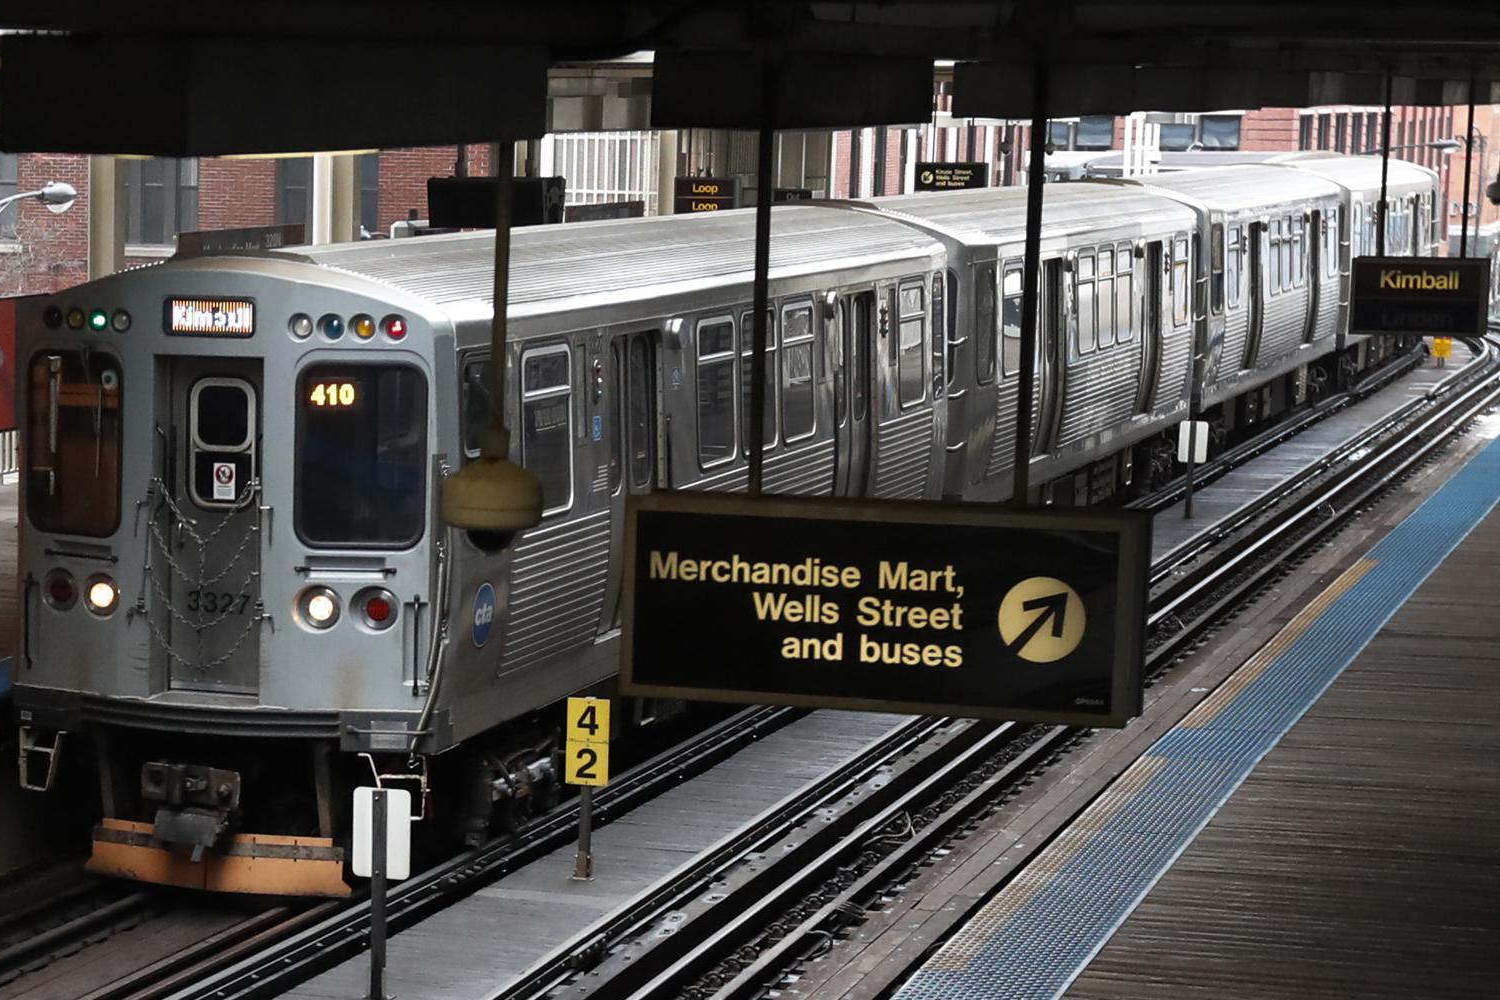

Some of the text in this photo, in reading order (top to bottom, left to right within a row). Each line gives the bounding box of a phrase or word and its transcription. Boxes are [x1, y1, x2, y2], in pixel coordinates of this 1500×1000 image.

[692, 183, 719, 195] Loop
[692, 201, 719, 211] Loop
[1380, 270, 1459, 290] Kimball
[310, 383, 355, 406] 410
[650, 551, 964, 598] Merchandise Mart,
[187, 590, 250, 615] 3327
[475, 603, 493, 626] cta
[753, 592, 964, 630] Wells Street
[781, 633, 963, 667] and buses
[577, 706, 599, 735] 4
[576, 748, 597, 778] 2
